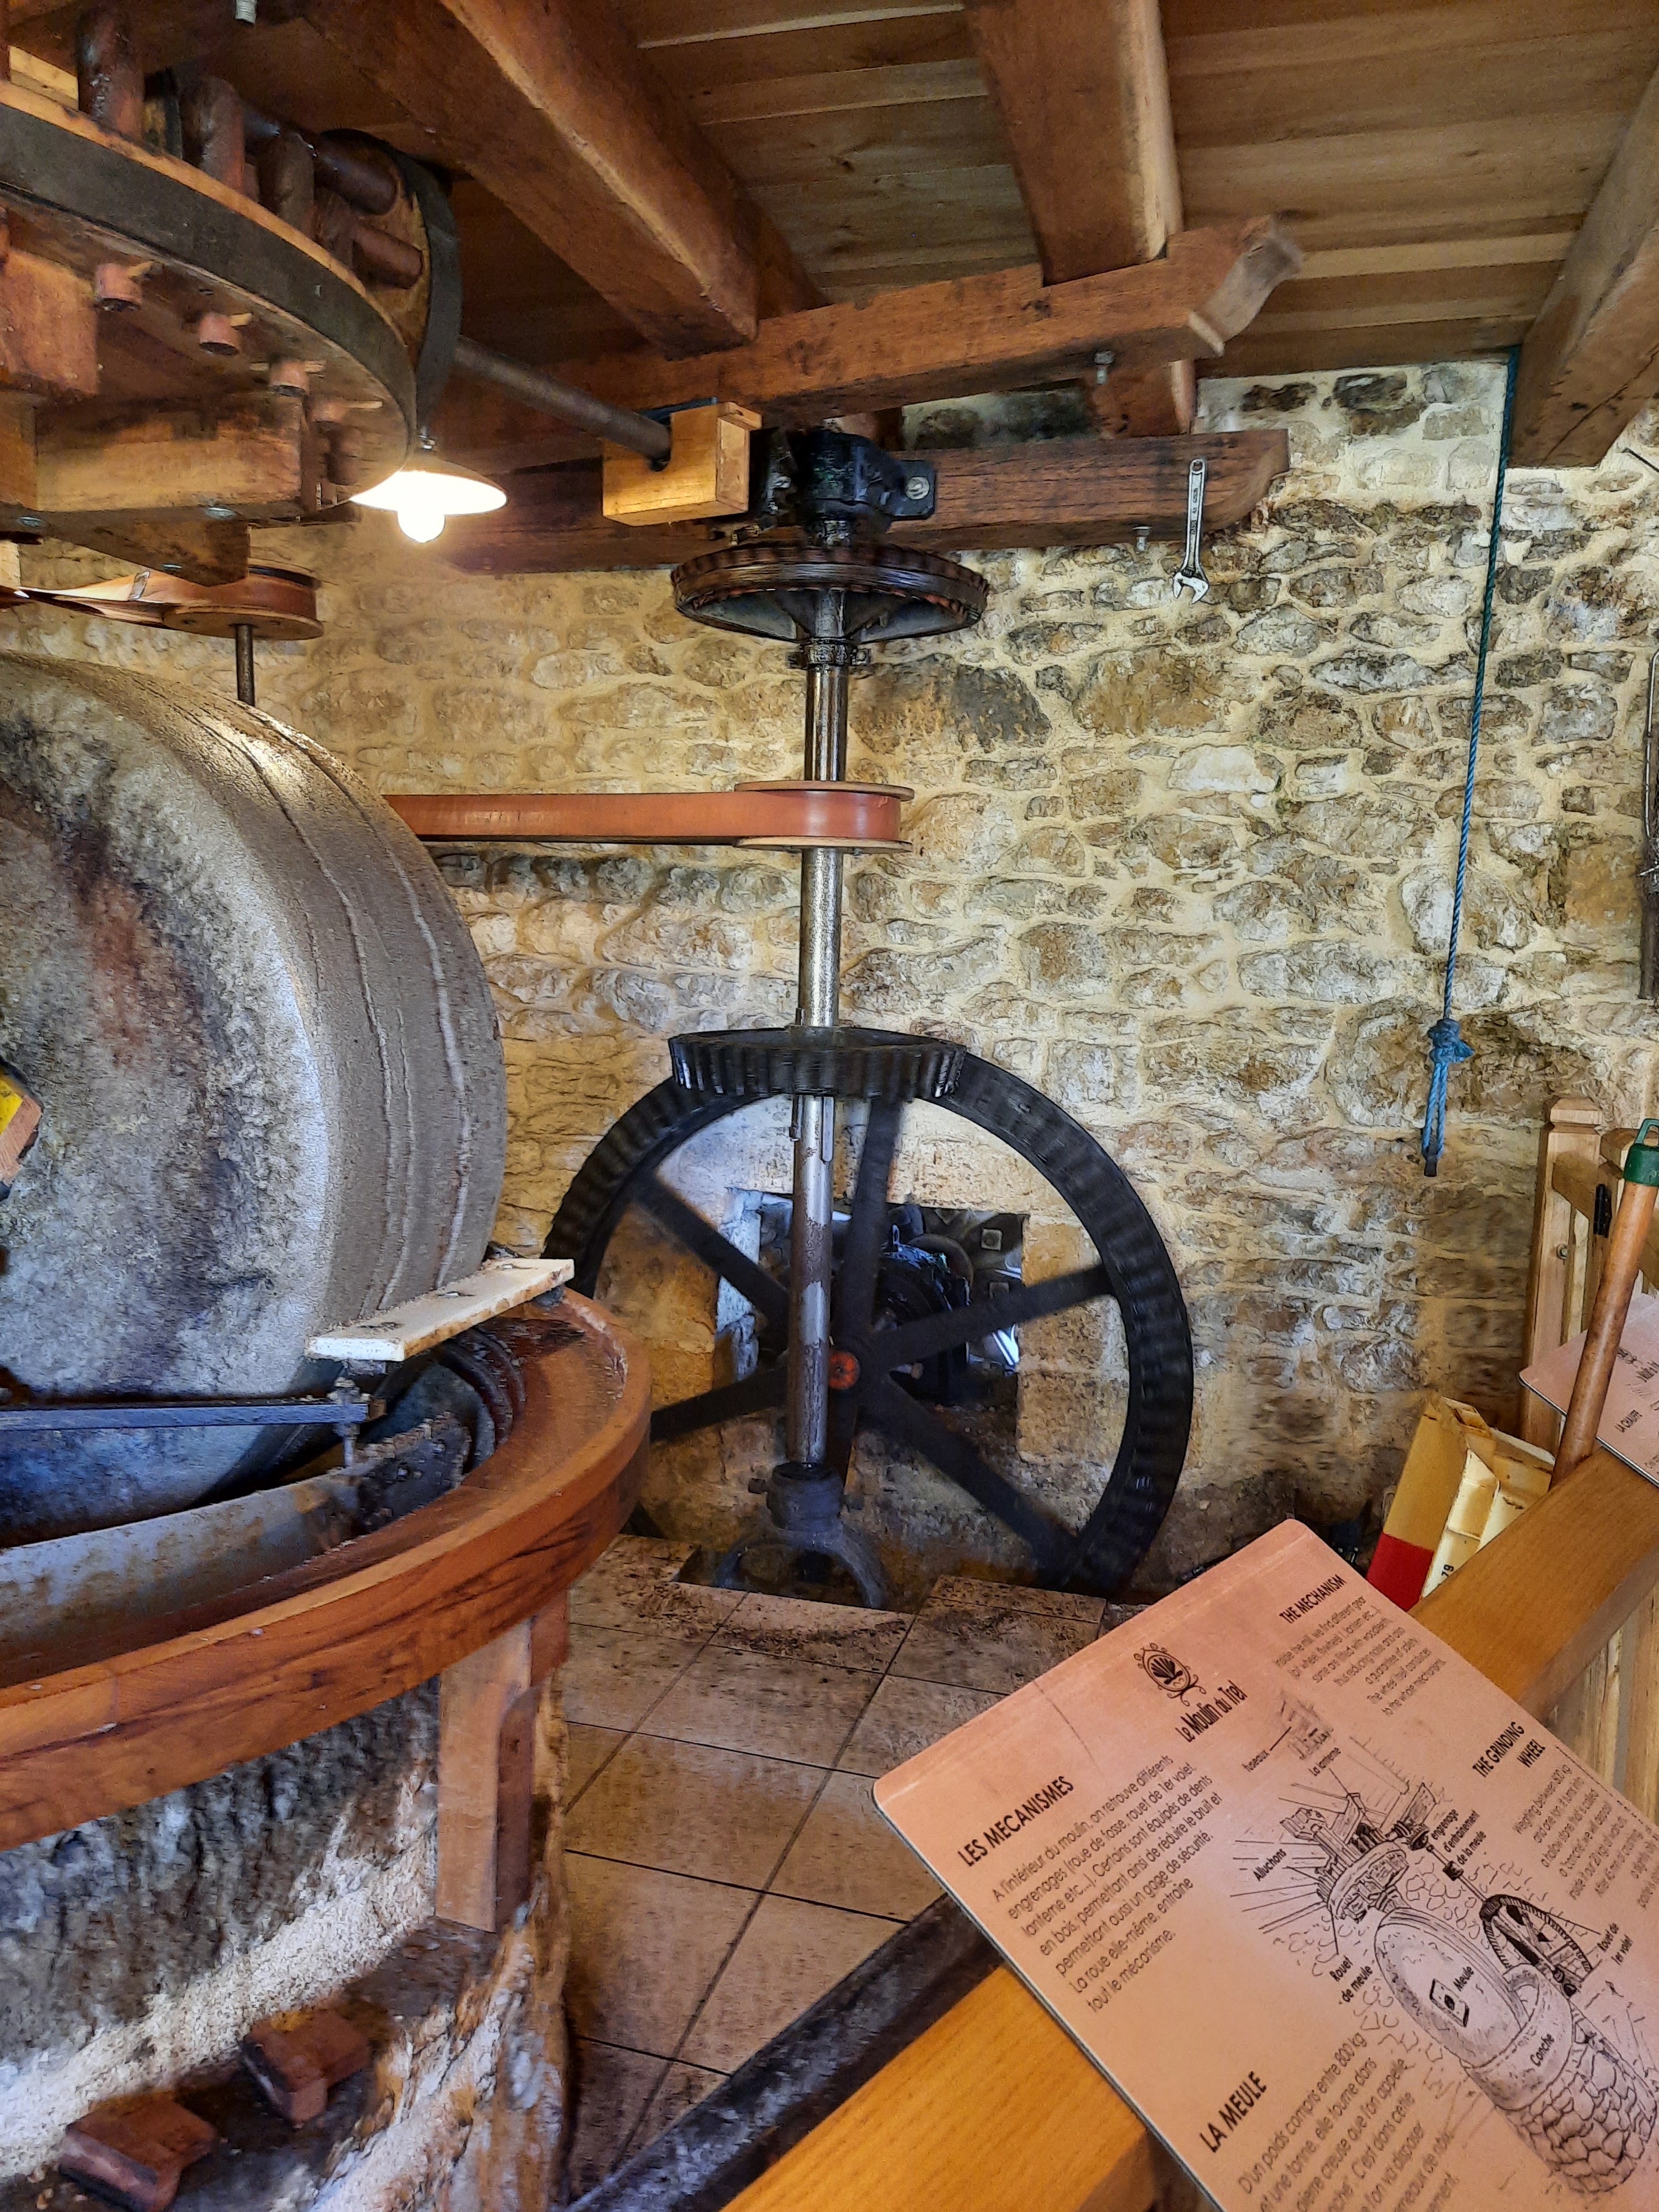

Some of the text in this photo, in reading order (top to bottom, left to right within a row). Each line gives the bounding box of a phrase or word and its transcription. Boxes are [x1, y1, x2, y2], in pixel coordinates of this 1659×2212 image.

[1279, 1574, 1346, 1624] THE MECHANISM
[1175, 1680, 1248, 1743] Le Moulin du Trel
[1242, 1750, 1270, 1772] fuseaux
[1308, 1747, 1341, 1776] La lanterne
[1472, 1721, 1525, 1777] THE GRINDING
[1517, 1739, 1546, 1768] WHEEL
[958, 1776, 1073, 1867] LES MECANISMES
[993, 1889, 1005, 1902] A
[1000, 1855, 1045, 1893] l'intérieur
[1045, 1846, 1060, 1860] du
[1090, 1810, 1105, 1823] on
[1102, 1783, 1139, 1811] retrouve
[1136, 1755, 1173, 1787] différents
[1431, 1809, 1458, 1840] engrenage
[1008, 1868, 1067, 1919] engrenages
[1063, 1848, 1092, 1874] (roue
[1090, 1838, 1105, 1851] de
[1126, 1798, 1151, 1822] rouet
[1148, 1791, 1162, 1803] de
[1157, 1779, 1175, 1792] 1er
[1021, 1900, 1066, 1937] lanterne
[1092, 1844, 1131, 1877] Certains
[1128, 1826, 1149, 1848] sont
[1145, 1802, 1181, 1832] équipés
[1177, 1793, 1191, 1806] de
[1189, 1776, 1213, 1797] dents
[1253, 1849, 1287, 1881] Alluchons
[1457, 1831, 1486, 1865] de la meule
[1040, 1939, 1056, 1956] en
[1077, 1873, 1129, 1926] permettant
[1127, 1855, 1149, 1879] ainsi
[1146, 1848, 1161, 1862] de
[1157, 1824, 1188, 1852] réduire
[1182, 1817, 1196, 1828] le
[1191, 1799, 1213, 1820] bruit
[1211, 1792, 1222, 1805] et
[1055, 1830, 1213, 1978] permettant aussi un gage de sécurité.
[1597, 1923, 1619, 1952] Rouet de
[1620, 1934, 1632, 1954] volet
[1070, 1977, 1088, 1994] La
[1084, 1956, 1110, 1981] roue
[1087, 1930, 1176, 2012] tout le mécanisme.
[1329, 1955, 1353, 1982] Rouet
[1342, 1966, 1373, 2002] de meule
[1453, 1966, 1474, 1992] Meule
[1530, 2033, 1554, 2067] Conche
[1355, 2057, 1377, 2086] dans
[1200, 2071, 1266, 2153] LA MEULE
[1261, 2130, 1290, 2171] poids
[1317, 2064, 1341, 2094] entre
[1334, 2043, 1355, 2067] 800
[1348, 2032, 1367, 2048] kg
